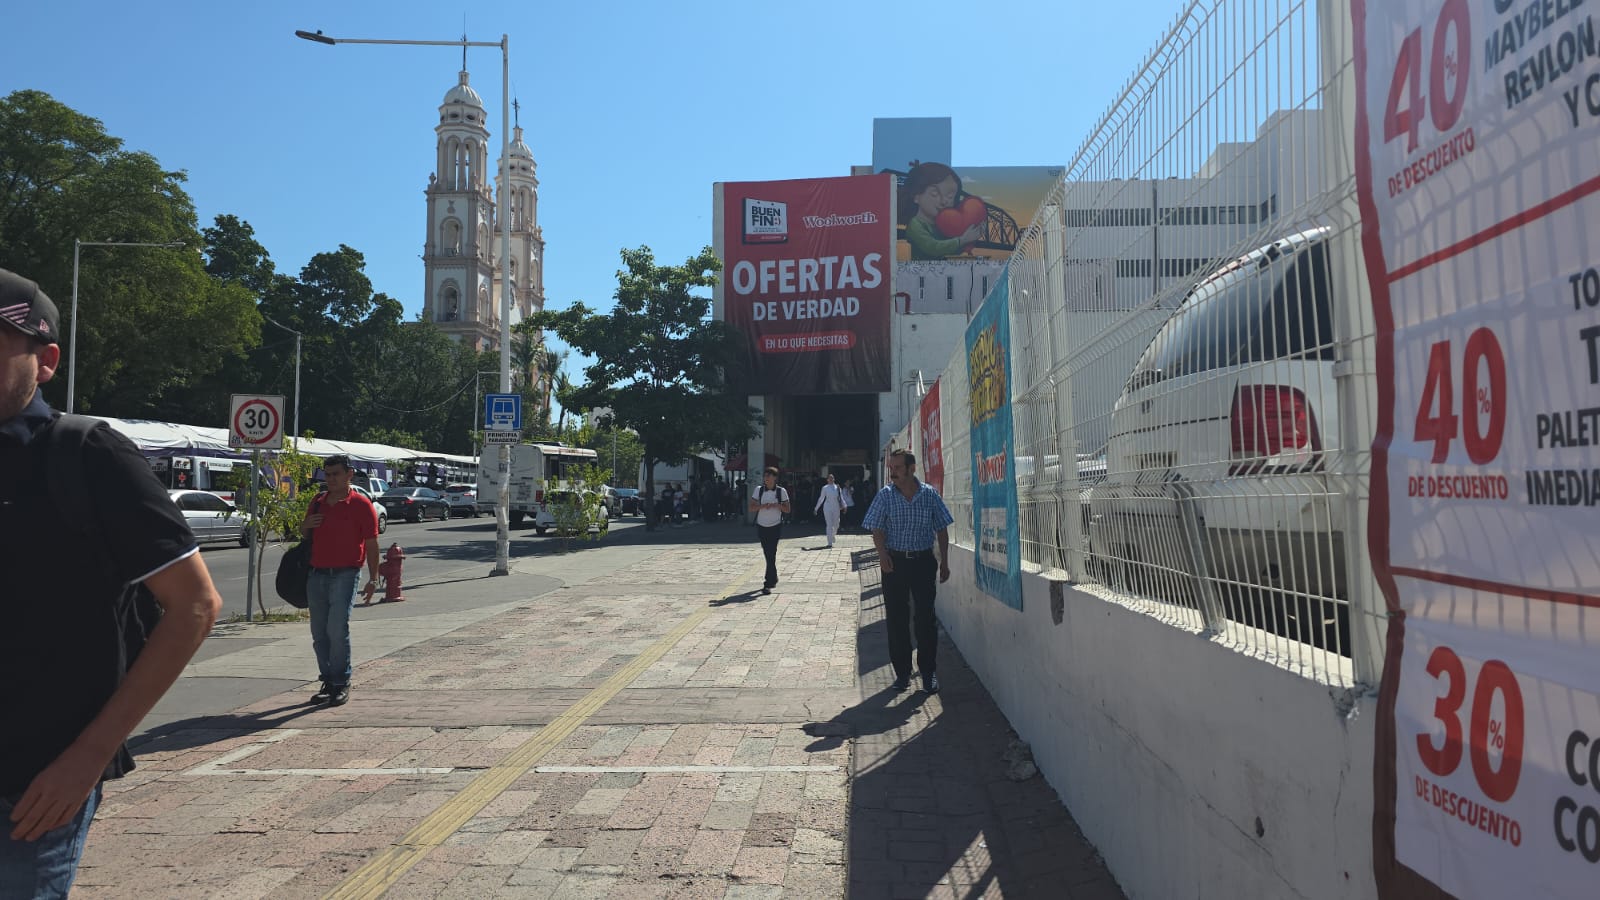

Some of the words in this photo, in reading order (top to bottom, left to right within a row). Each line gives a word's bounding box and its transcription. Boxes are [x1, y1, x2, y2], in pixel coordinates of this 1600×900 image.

[1504, 14, 1600, 110] REVLON
[1388, 176, 1403, 198] DE
[1403, 127, 1475, 190] DESCUENTO
[751, 205, 781, 217] BUEN
[732, 252, 883, 295] OFERTAS
[753, 301, 778, 321] DE
[781, 297, 860, 320] VERDAD
[765, 338, 776, 350] EN
[777, 337, 788, 349] LO
[790, 336, 806, 349] QUE
[807, 334, 849, 348] NECESITAS
[244, 408, 270, 429] 30
[1408, 475, 1425, 498] DE
[1427, 475, 1509, 500] DESCUENTO
[1415, 775, 1430, 802] DE
[1432, 784, 1522, 848] DESCUENTO
[1553, 795, 1600, 864] CO
